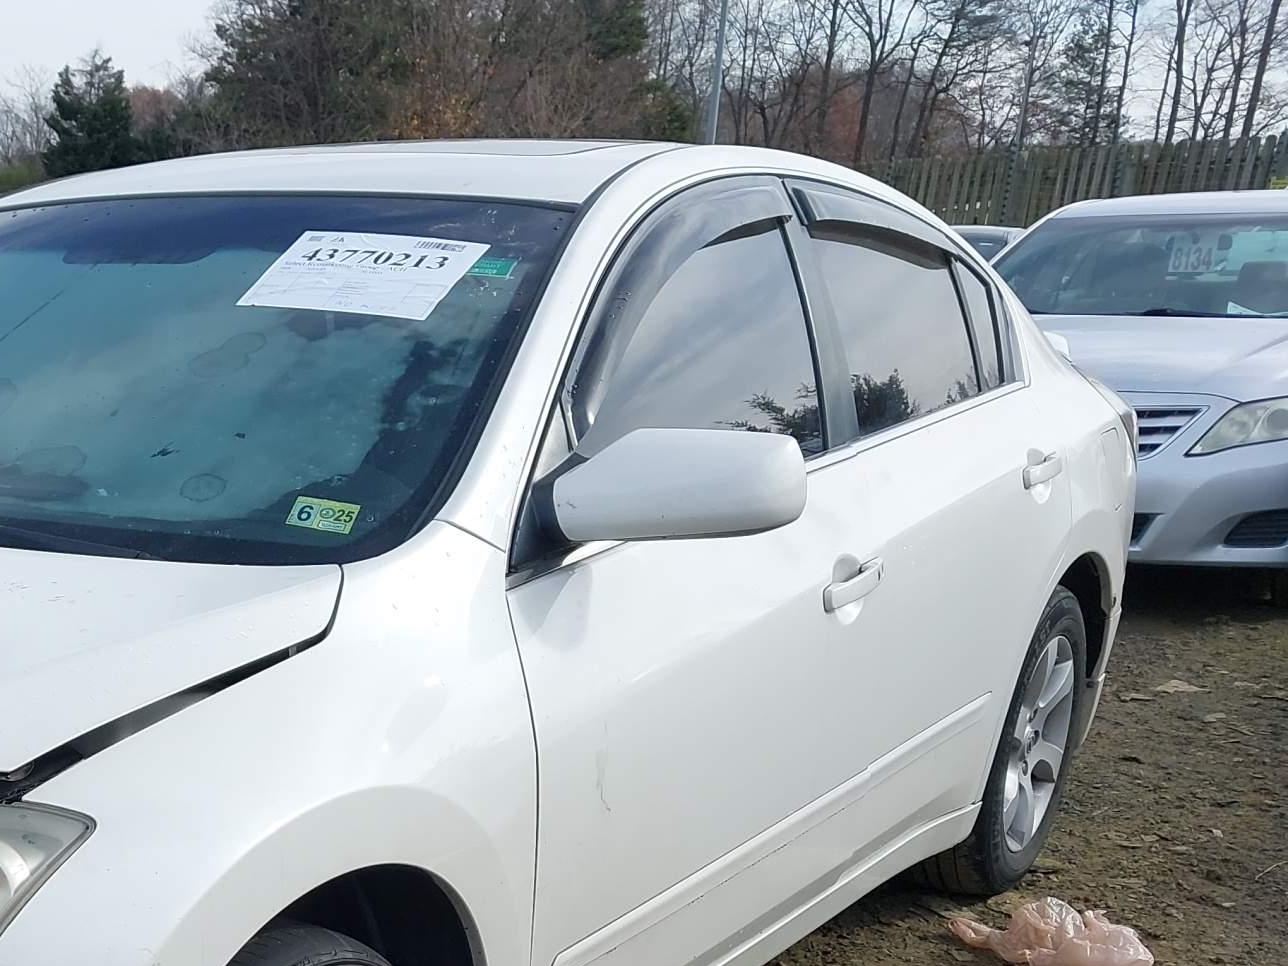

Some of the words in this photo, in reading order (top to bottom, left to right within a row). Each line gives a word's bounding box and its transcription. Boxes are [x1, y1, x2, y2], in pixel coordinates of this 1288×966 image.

[301, 247, 450, 270] 43770213
[1171, 247, 1213, 271] 8134
[296, 504, 314, 522] 6
[333, 508, 356, 524] 25
